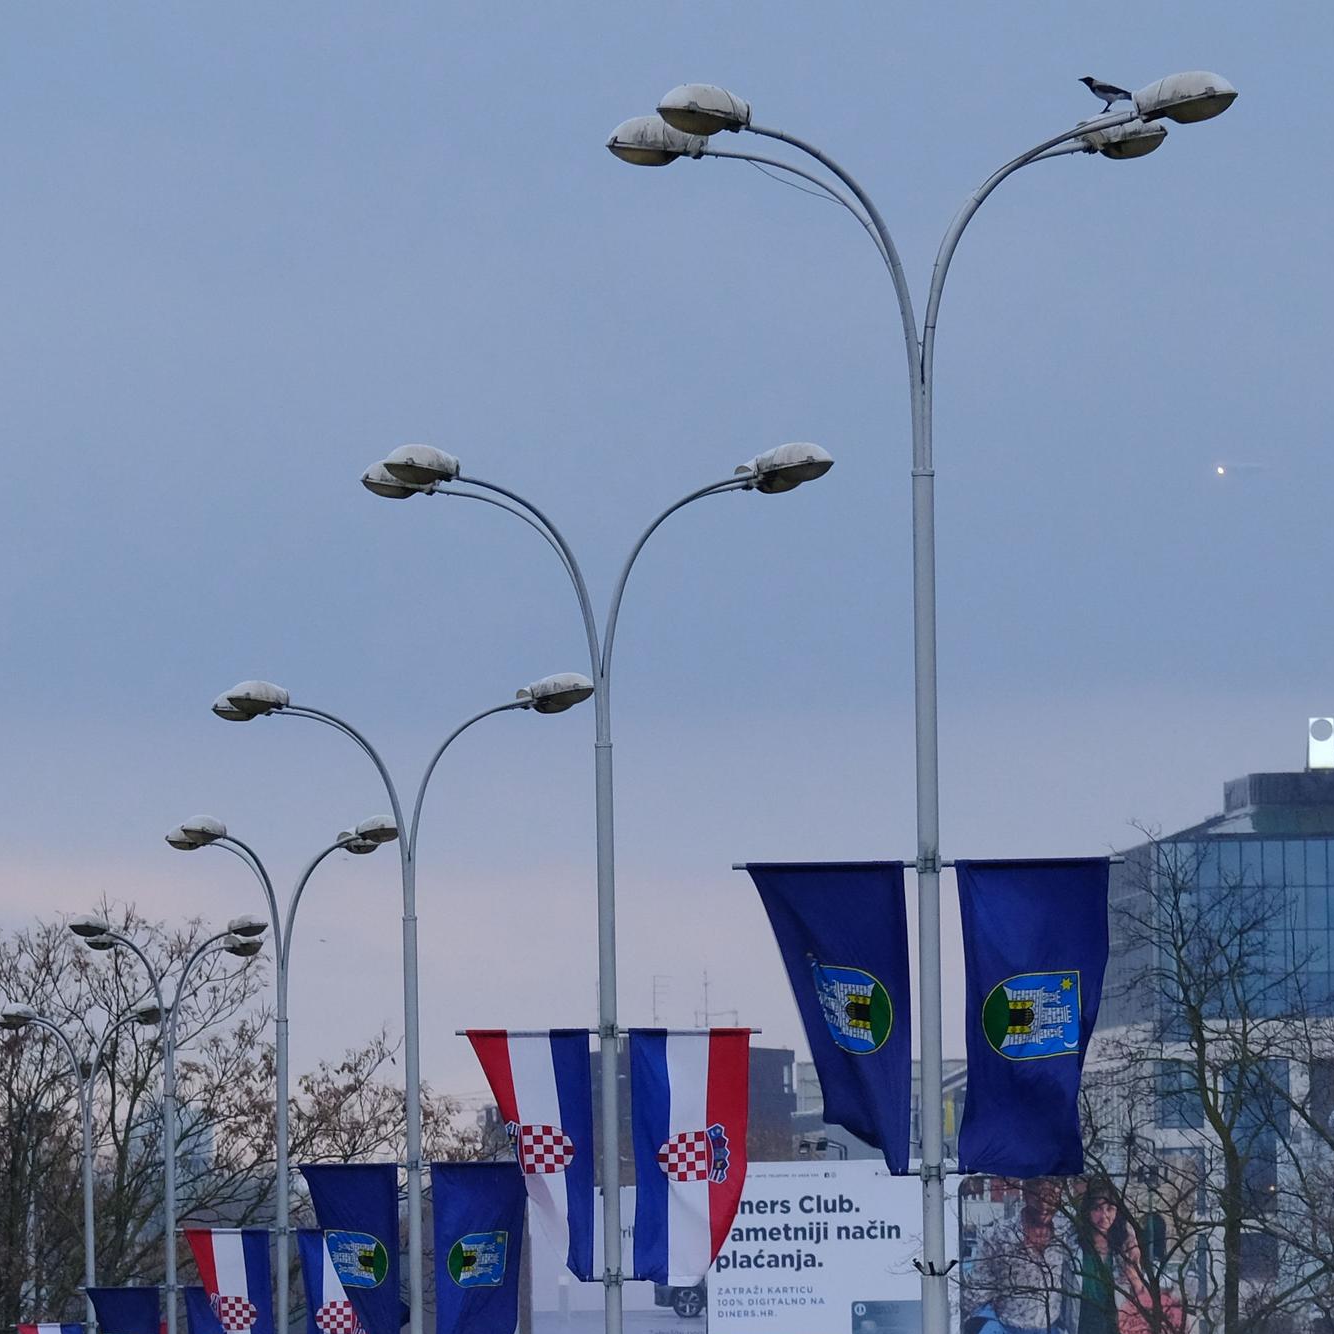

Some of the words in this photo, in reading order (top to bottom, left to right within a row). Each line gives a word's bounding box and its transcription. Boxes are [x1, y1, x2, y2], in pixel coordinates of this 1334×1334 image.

[736, 1199, 792, 1216] ners
[798, 1194, 860, 1214] Club.
[730, 1221, 829, 1245] ametniji
[836, 1219, 902, 1241] način
[715, 1248, 824, 1273] plaćanja.
[717, 1285, 764, 1296] ZATRAŽI
[767, 1285, 815, 1295] KARTICU
[717, 1298, 745, 1307] 100%
[747, 1296, 807, 1306] DIGITALNO
[810, 1296, 826, 1305] NA
[717, 1307, 779, 1319] DINERS.HR.
